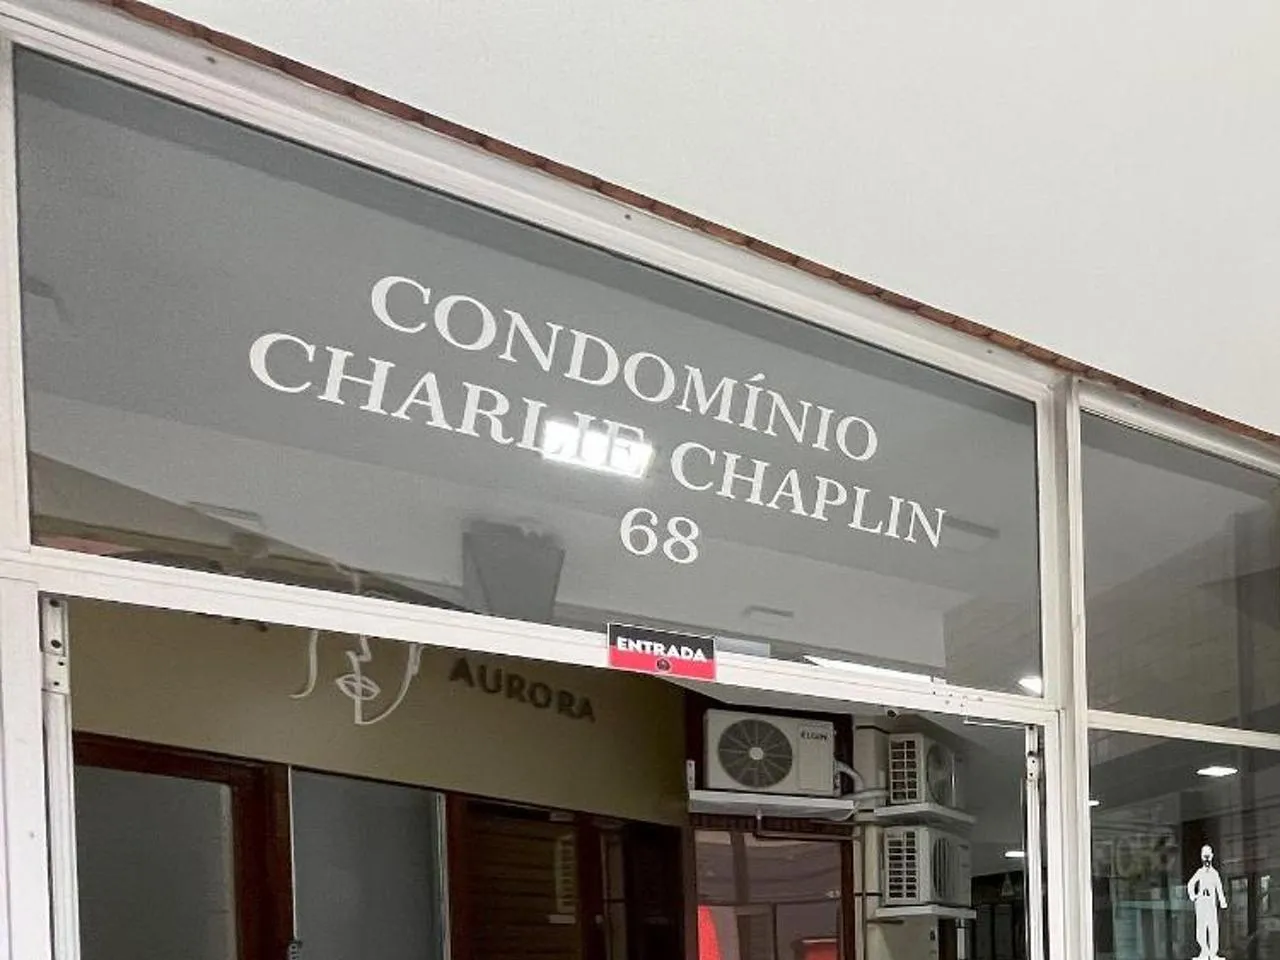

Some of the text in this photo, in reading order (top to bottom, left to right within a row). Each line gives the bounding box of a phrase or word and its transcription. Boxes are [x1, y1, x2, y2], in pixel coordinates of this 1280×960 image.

[370, 275, 879, 462] CONDOMÍNIO
[248, 333, 947, 549] CHARLIE CHAPLIN
[619, 507, 701, 565] 68
[616, 635, 708, 663] ENTRADA
[448, 656, 597, 723] AURORA
